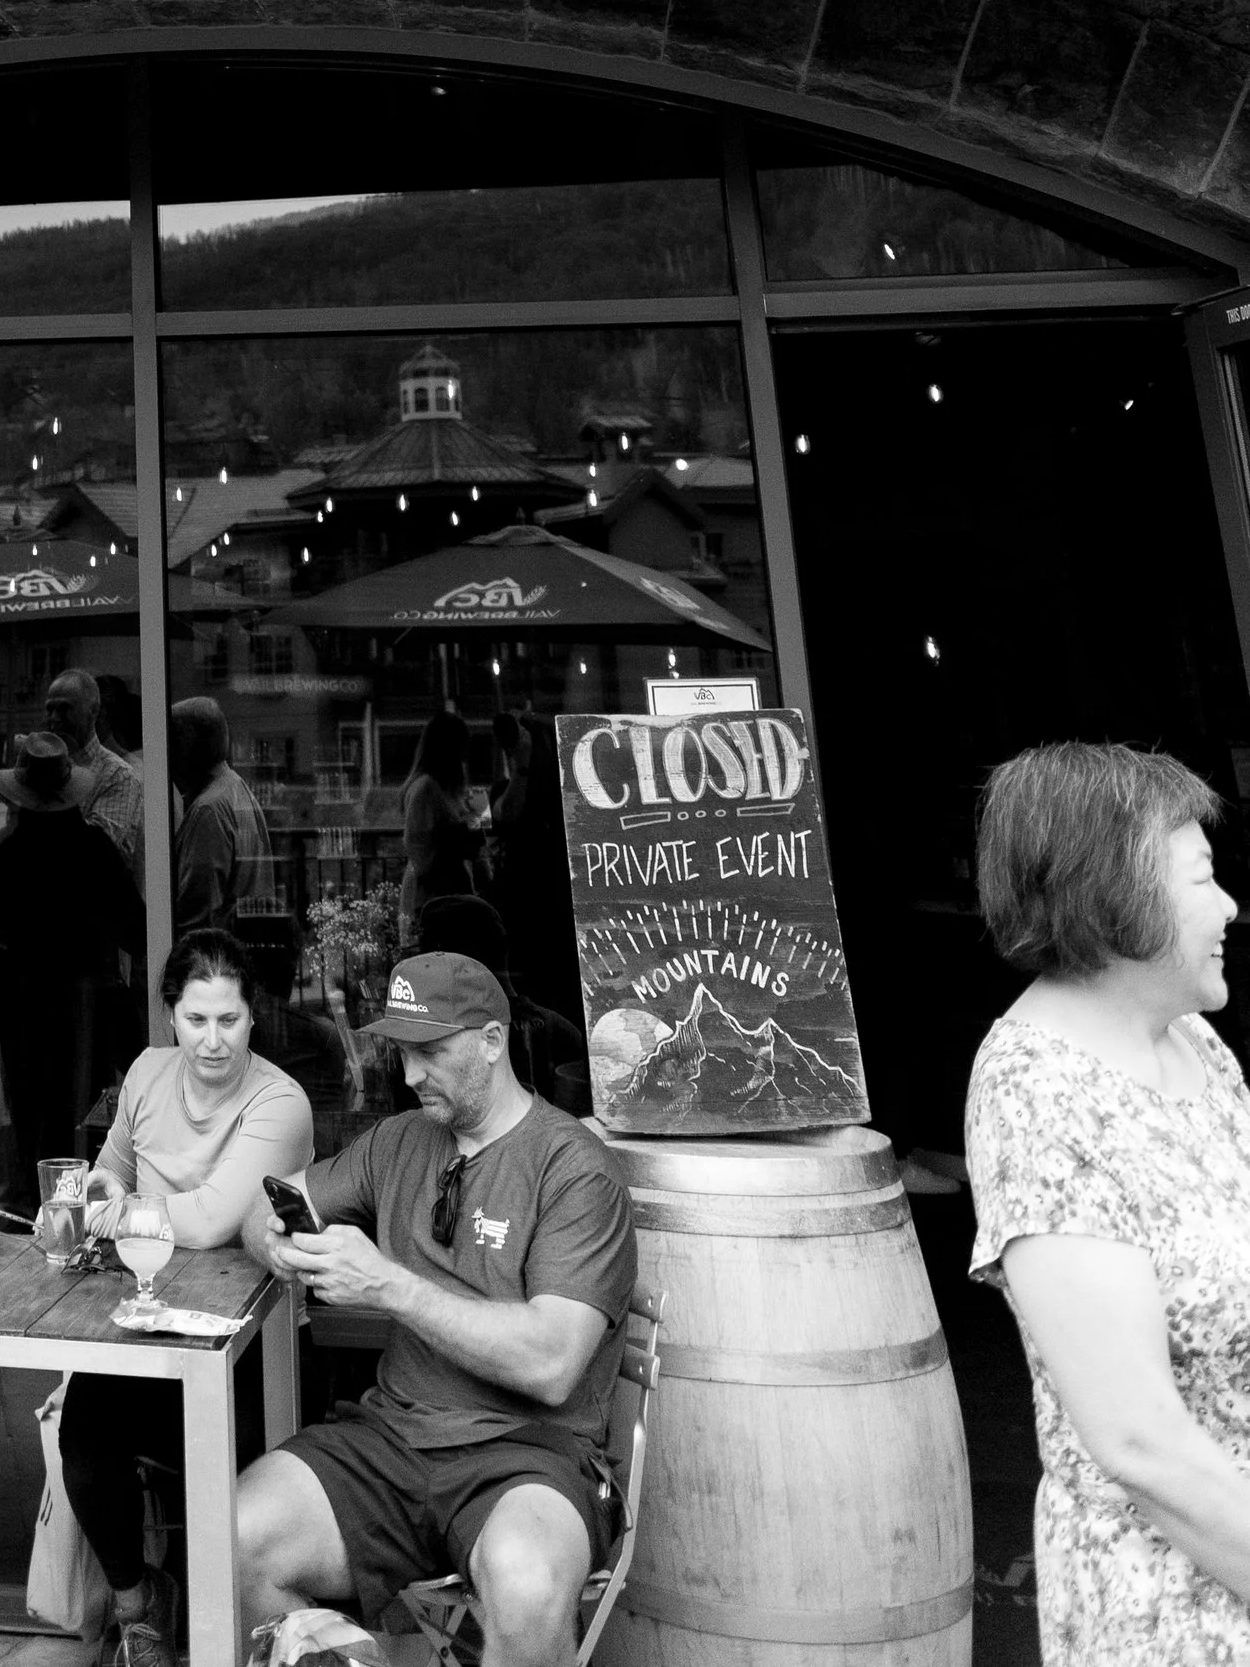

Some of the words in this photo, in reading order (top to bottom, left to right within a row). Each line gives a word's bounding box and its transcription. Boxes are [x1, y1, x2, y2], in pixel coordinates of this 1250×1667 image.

[572, 717, 805, 810] CLOSED
[581, 840, 700, 887] PRIVATE
[715, 830, 812, 880] EVENT
[631, 949, 790, 1004] MOUNTAINS
